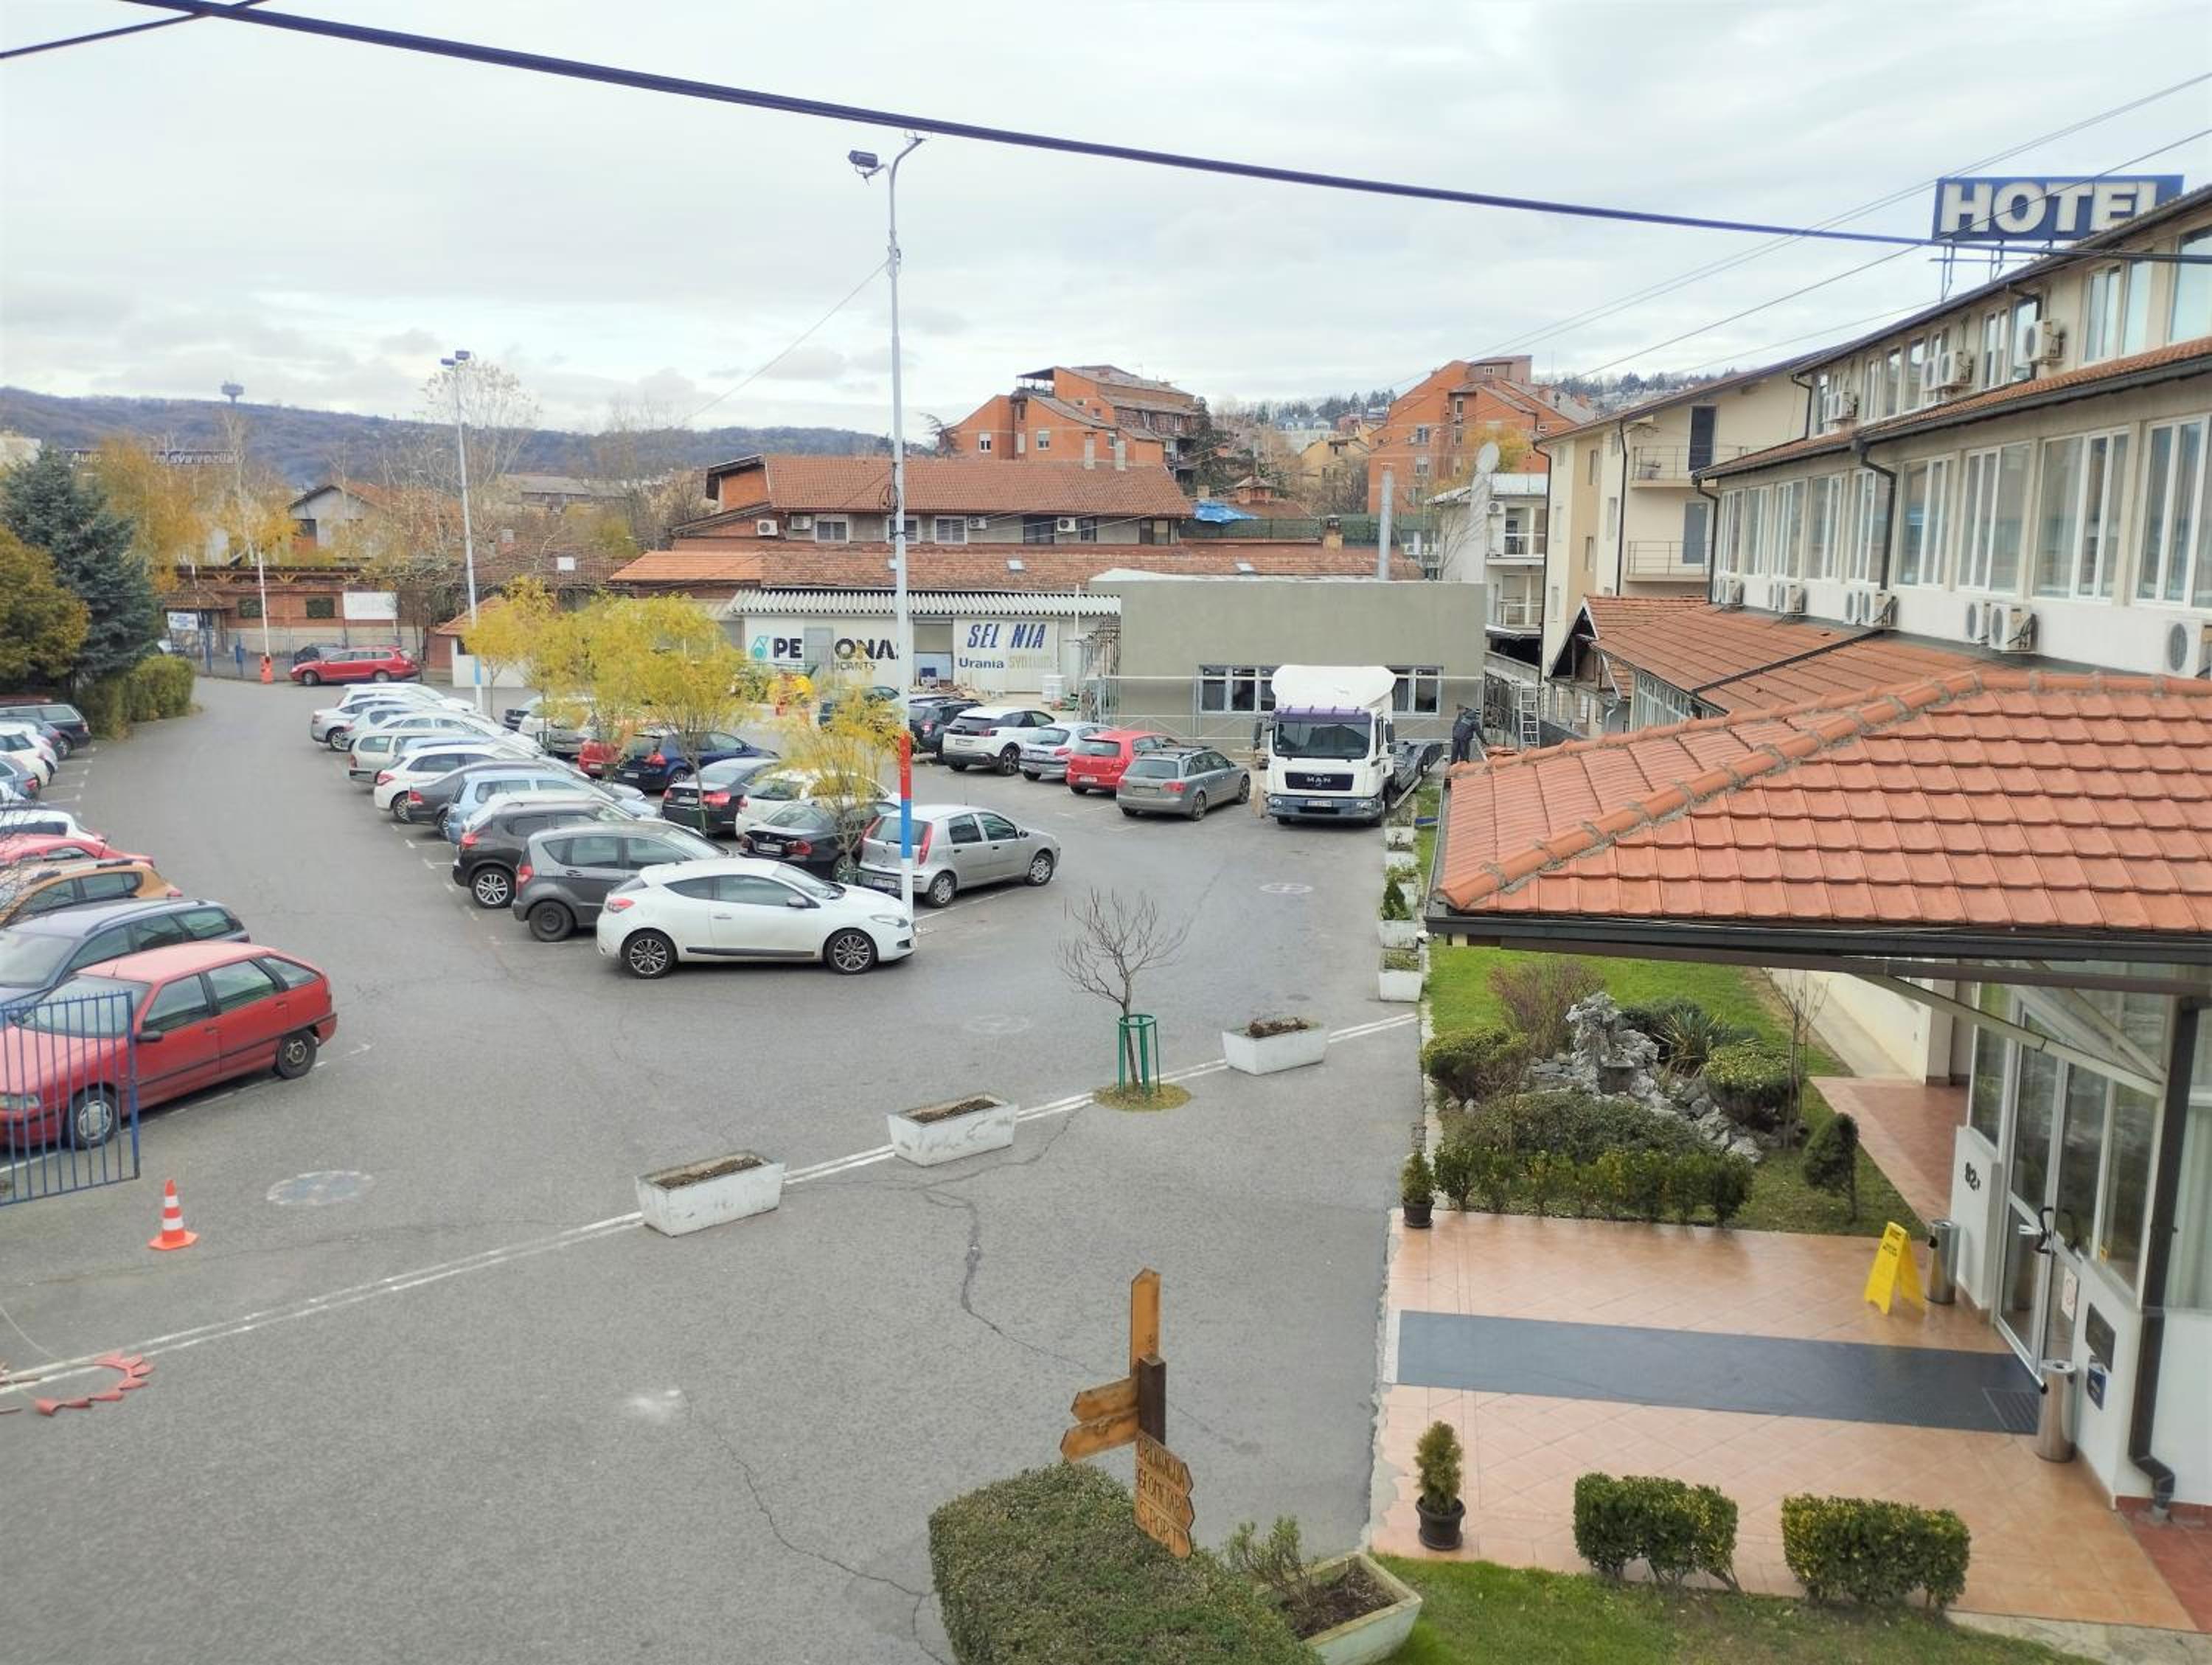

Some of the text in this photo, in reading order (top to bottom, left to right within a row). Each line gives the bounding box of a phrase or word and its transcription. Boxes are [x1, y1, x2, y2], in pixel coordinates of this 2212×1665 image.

[773, 638, 899, 660] PEONA
[959, 657, 1004, 669] Urania
[1306, 776, 1332, 784] MAN
[1138, 1500, 1178, 1547] SPORT
